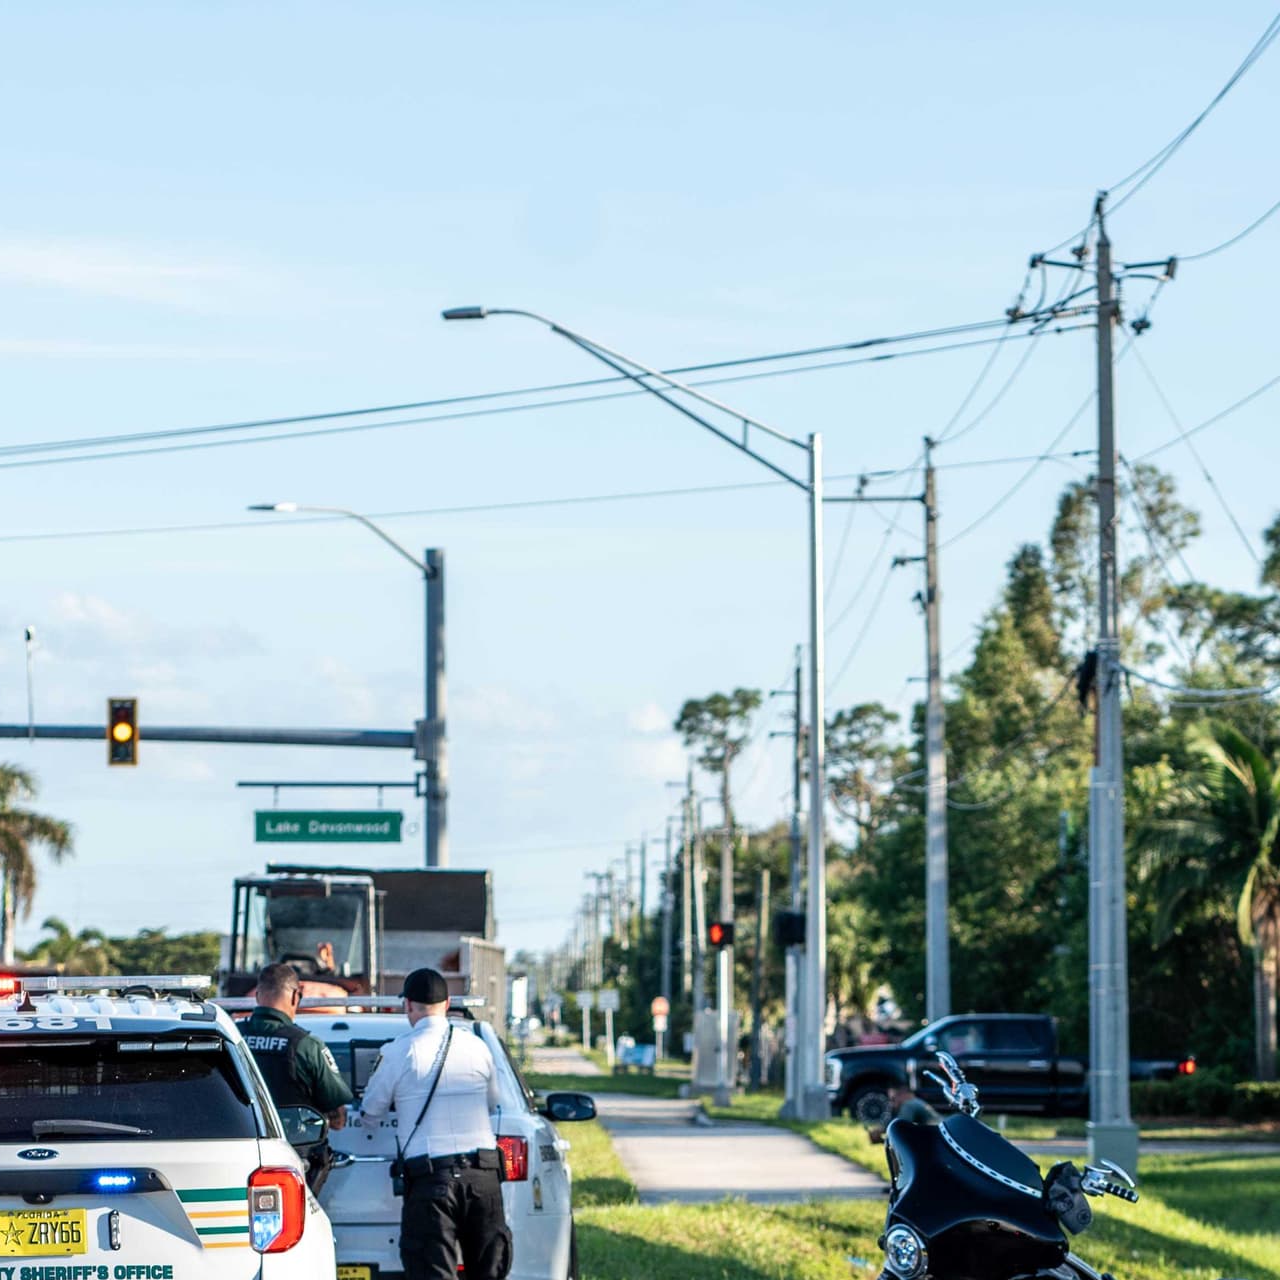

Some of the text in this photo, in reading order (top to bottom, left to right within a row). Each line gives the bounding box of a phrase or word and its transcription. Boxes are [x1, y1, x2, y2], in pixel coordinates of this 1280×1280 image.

[265, 820, 391, 834] Lake Devonwood
[245, 1035, 288, 1050] ERIFF
[27, 1220, 81, 1244] ZRY66
[114, 1265, 174, 1280] OFFICE
